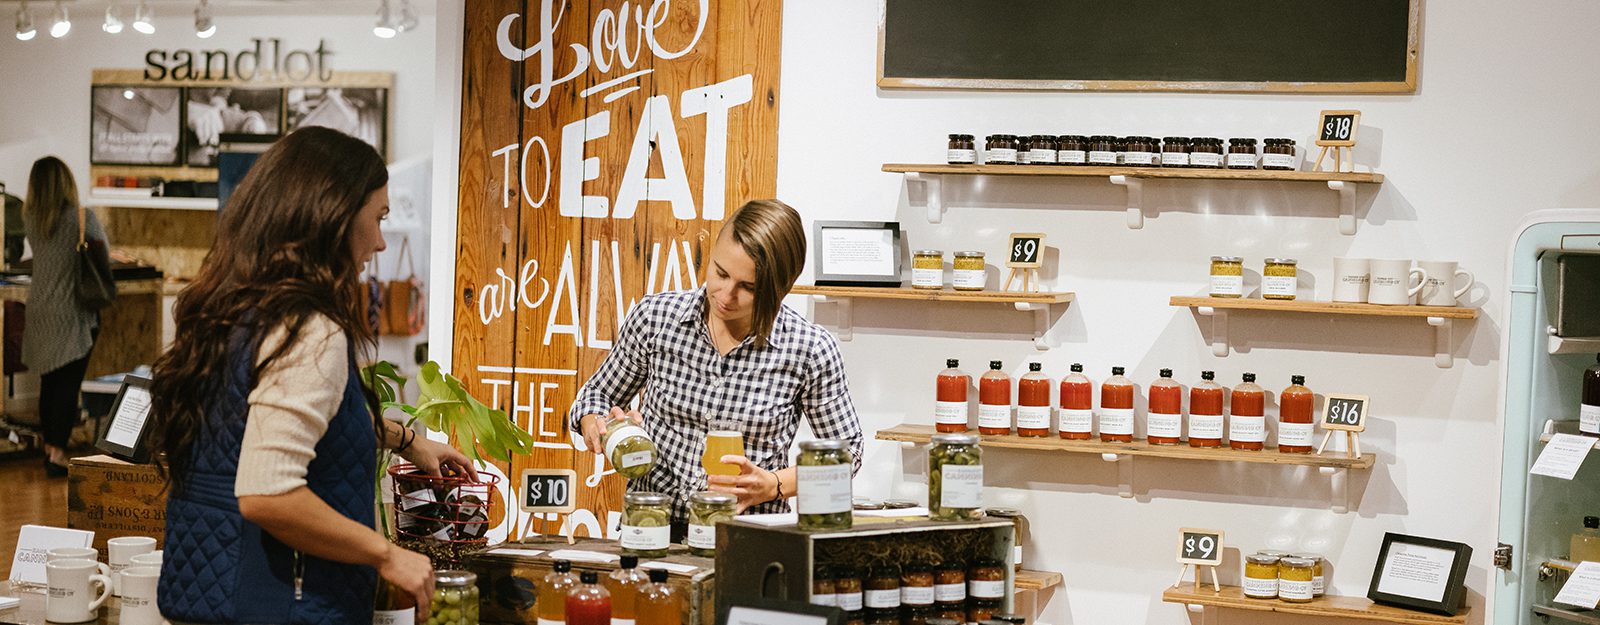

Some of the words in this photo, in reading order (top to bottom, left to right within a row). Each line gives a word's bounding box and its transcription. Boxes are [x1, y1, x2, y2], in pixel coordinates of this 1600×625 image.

[144, 38, 334, 81] sandlot
[497, 0, 709, 109] Love
[492, 136, 550, 208] TO
[560, 74, 753, 220] EAT
[1326, 117, 1351, 139] $18
[1014, 239, 1037, 262] $9
[478, 259, 550, 325] are
[543, 239, 699, 349] ALWA
[481, 378, 559, 436] THE
[1331, 400, 1359, 425] $16
[1185, 535, 1215, 559] $9
